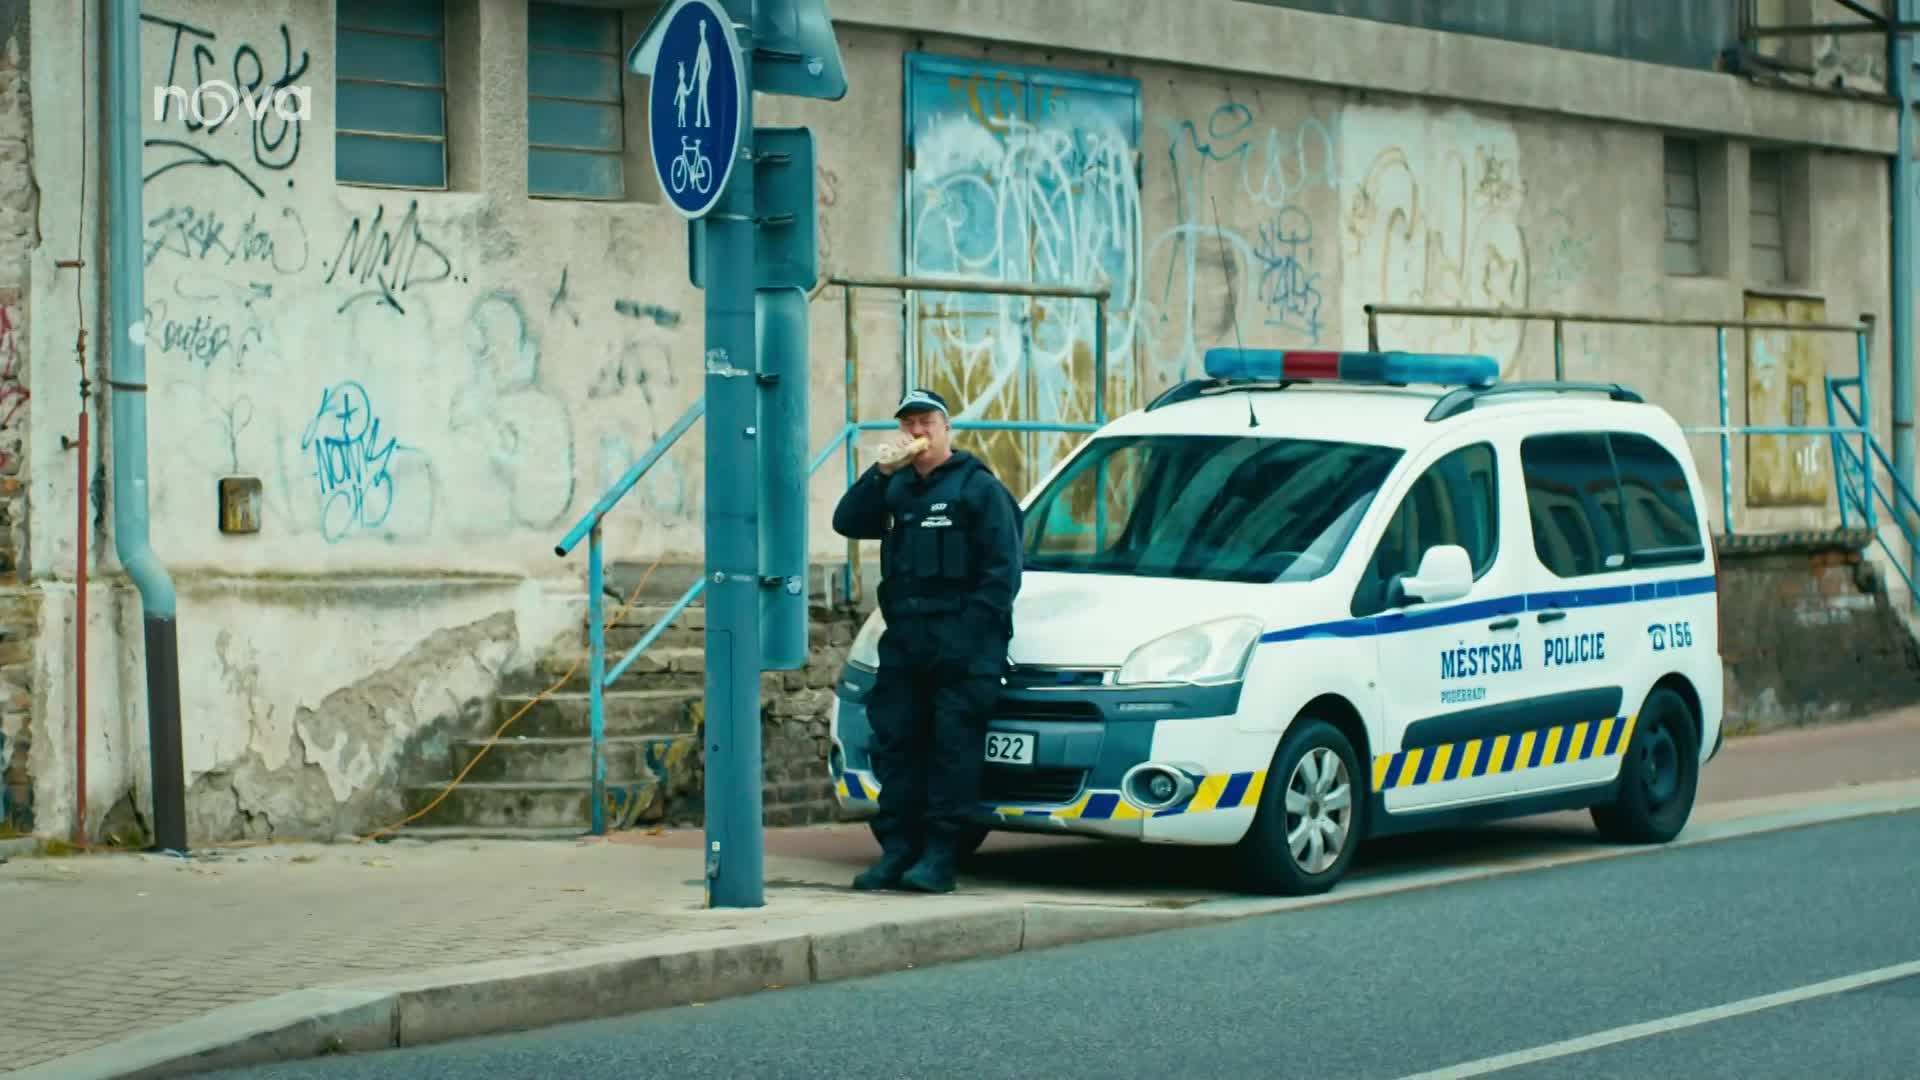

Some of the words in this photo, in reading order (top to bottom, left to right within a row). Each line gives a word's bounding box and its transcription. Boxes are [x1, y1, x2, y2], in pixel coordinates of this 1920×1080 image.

[1669, 622, 1692, 648] 156
[1441, 632, 1522, 680] MĚSTSKÁ
[1543, 631, 1605, 668] POLICIE
[987, 735, 1024, 761] 622
